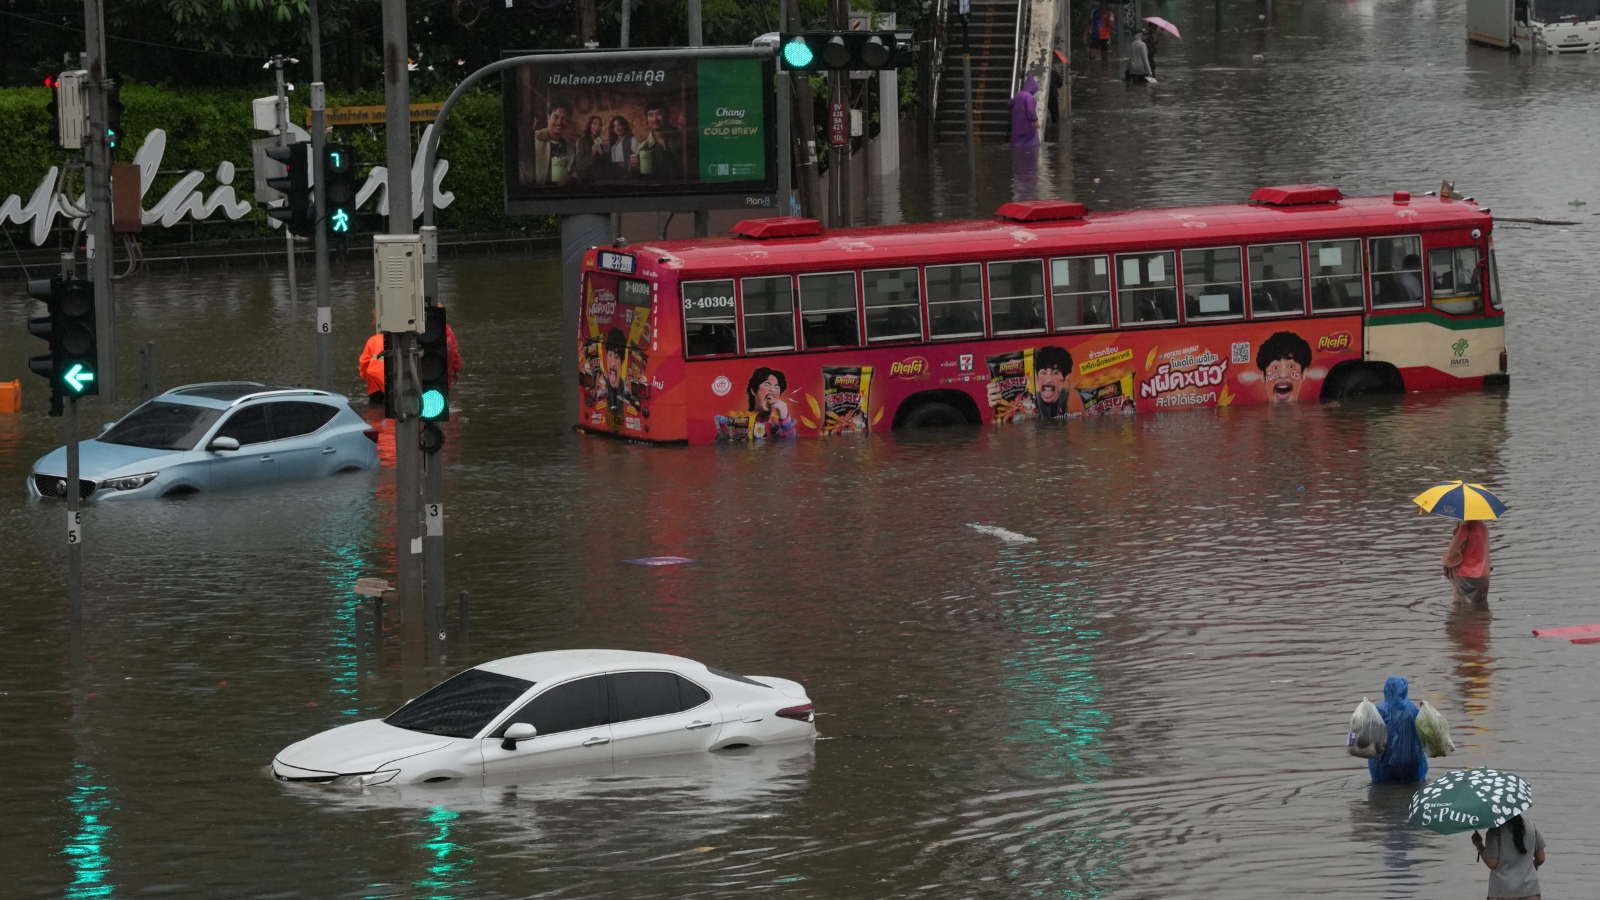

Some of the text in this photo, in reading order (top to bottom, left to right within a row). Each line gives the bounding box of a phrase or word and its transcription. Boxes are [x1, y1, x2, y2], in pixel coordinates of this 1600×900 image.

[548, 70, 665, 86] เปิดโลกความชิลให้คูล
[715, 107, 746, 118] Chang
[703, 126, 758, 136] COLD BREW
[330, 152, 340, 167] 7
[610, 254, 622, 269] 23
[625, 281, 650, 296] 3-40304
[684, 295, 735, 310] 3-40304
[322, 322, 329, 333] 6
[1088, 346, 1119, 359] ข้าวเกรียบ
[1163, 349, 1182, 360] POTATO
[1450, 358, 1470, 366] BMTA
[652, 376, 665, 390] ใหม่
[1155, 389, 1217, 408] สะใจได้เรื่อยๆ
[429, 504, 439, 517] 3
[75, 512, 81, 525] 5
[69, 530, 77, 543] 5
